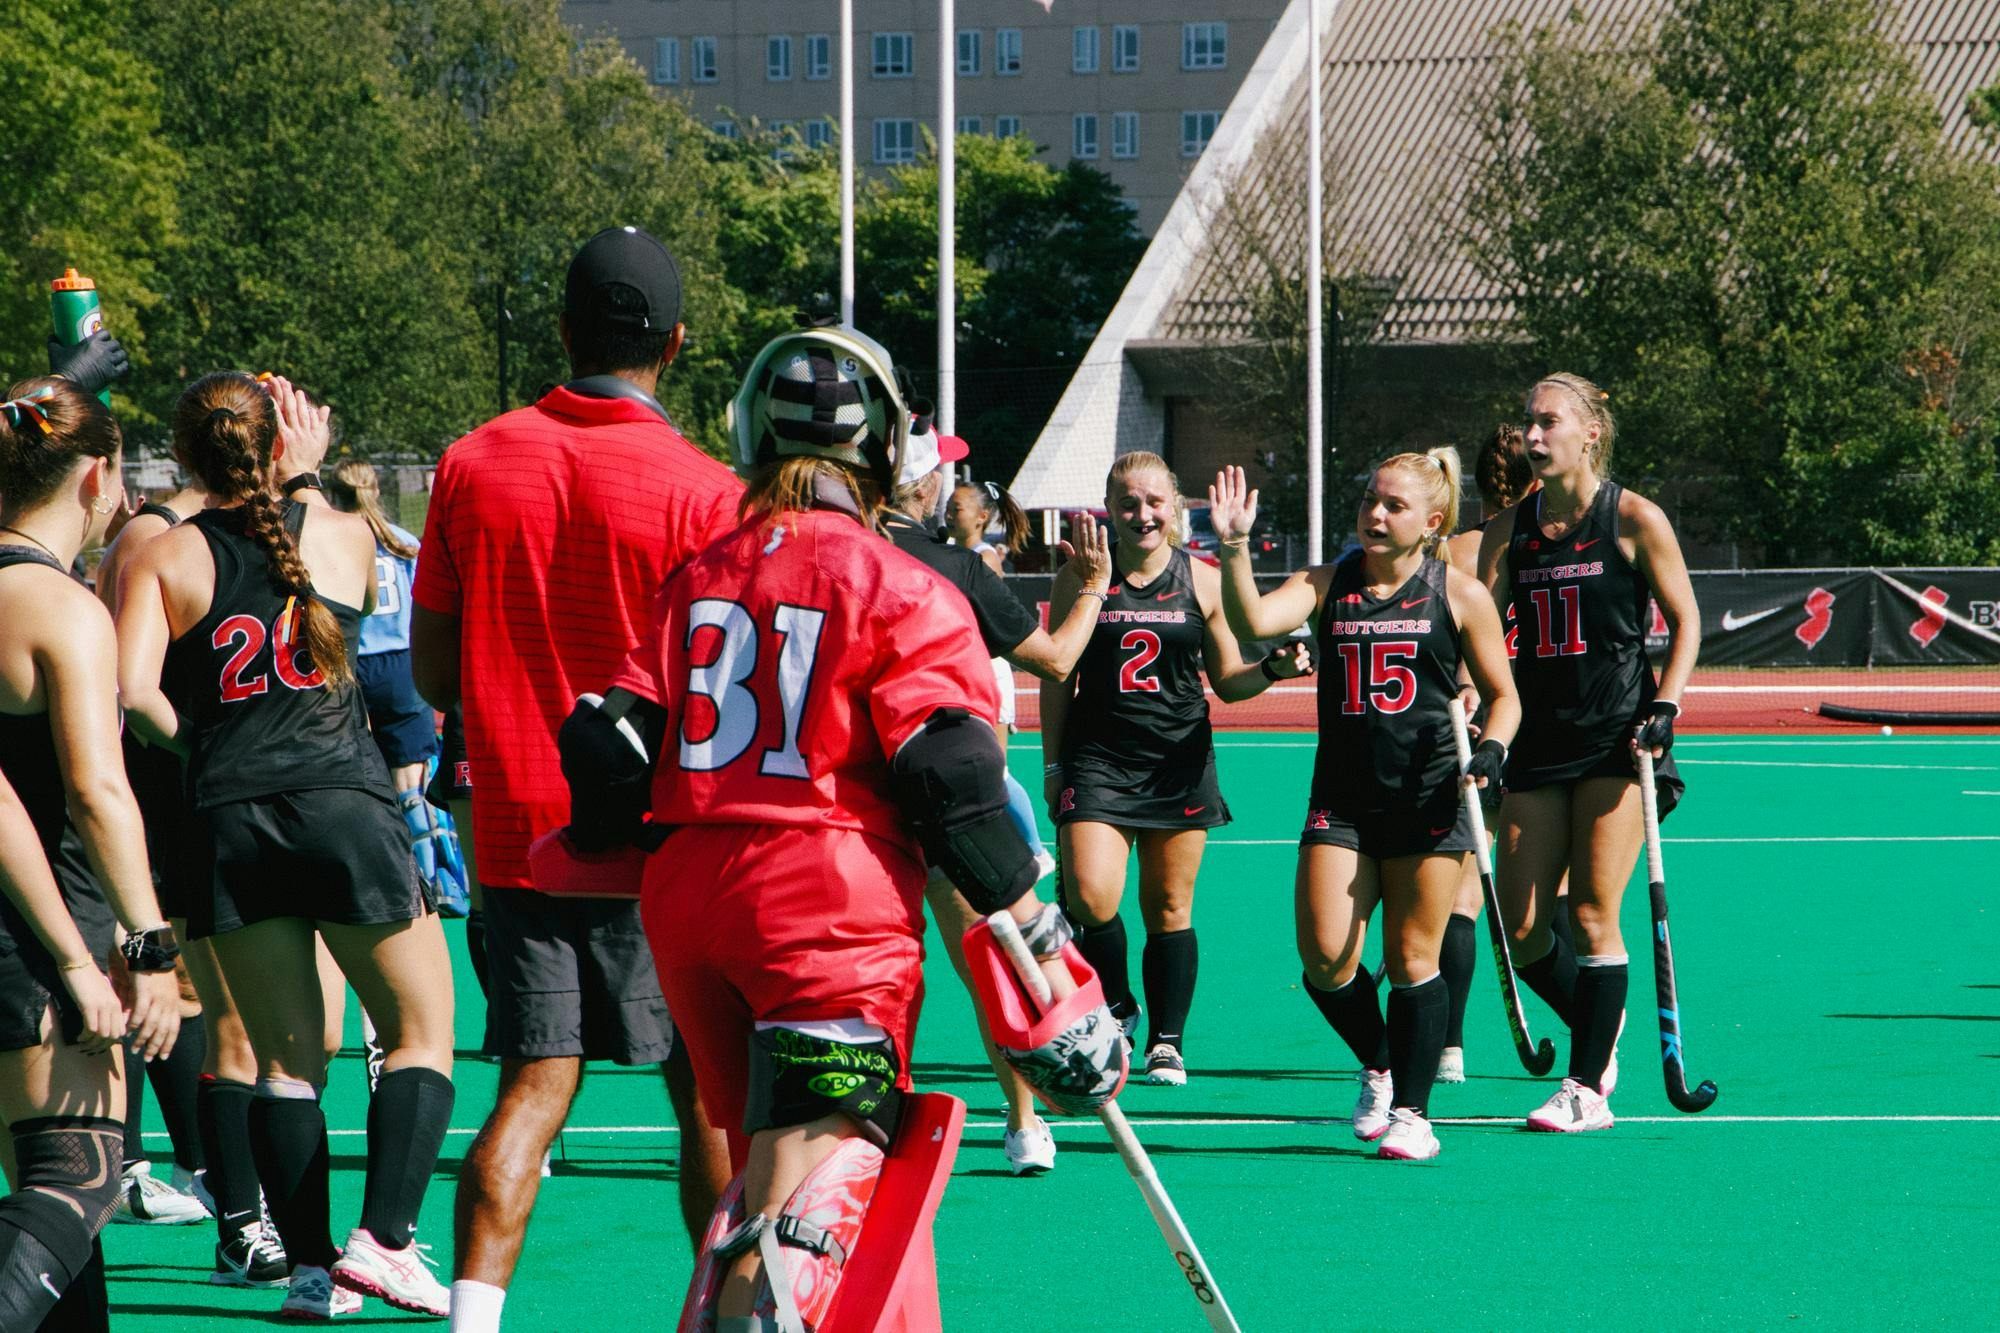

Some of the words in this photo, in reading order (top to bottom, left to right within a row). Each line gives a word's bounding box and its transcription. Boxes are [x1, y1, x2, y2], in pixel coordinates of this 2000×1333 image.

[1518, 561, 1603, 583] RUTGERS
[1098, 610, 1186, 624] RUTGERS
[1332, 619, 1432, 636] RUTGERS
[1531, 585, 1587, 658] 11
[1119, 628, 1162, 693] 2
[1337, 641, 1418, 715] 15
[678, 597, 828, 780] 31
[454, 761, 473, 787] R
[814, 1075, 859, 1092] OBO
[1175, 1250, 1215, 1305] OBO
